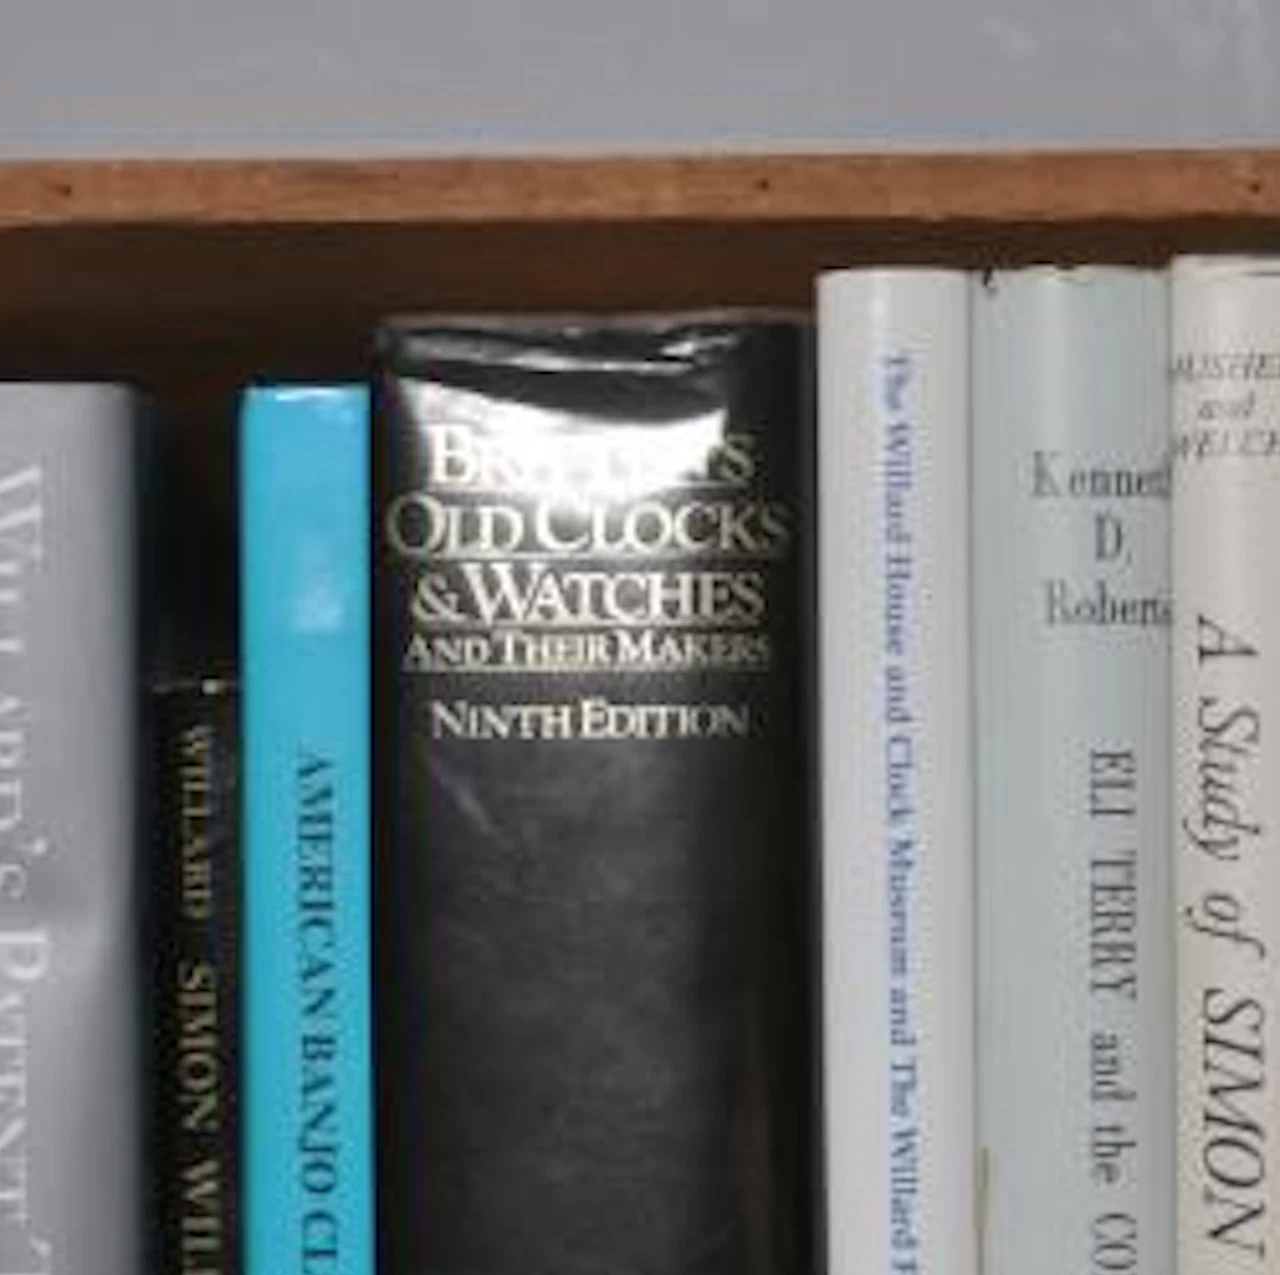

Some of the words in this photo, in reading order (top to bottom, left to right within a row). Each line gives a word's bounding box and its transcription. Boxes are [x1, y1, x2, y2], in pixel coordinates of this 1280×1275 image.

[882, 352, 914, 411] The
[883, 420, 916, 543] Willard
[1031, 449, 1172, 499] Kennet
[387, 492, 523, 558] OLD
[535, 490, 792, 558] CLOCKS
[411, 573, 463, 626] &
[464, 560, 766, 629] WATCHES
[884, 553, 915, 656] House
[406, 635, 490, 668] AND
[494, 630, 609, 665] THEIR
[613, 629, 772, 665] MAKERS
[1197, 613, 1261, 666] A
[432, 700, 573, 740] NINTH
[580, 696, 756, 741] EDITION
[884, 665, 917, 725] and
[884, 735, 919, 826] Clock
[1089, 748, 1136, 819] ELI
[1183, 696, 1262, 863] Study
[178, 722, 216, 921] WILLARD
[297, 752, 336, 1019] AMERICAN
[888, 838, 918, 977] Museum
[1089, 850, 1138, 1001] TERRY
[1184, 890, 1267, 959] of
[177, 957, 221, 1132] SIMON
[889, 987, 918, 1046] and
[890, 1057, 920, 1117] The
[1091, 1031, 1138, 1101] and
[297, 1033, 338, 1197] BANJO
[1202, 987, 1267, 1259] SIMON
[890, 1127, 921, 1250] Willard
[1092, 1124, 1139, 1185] the
